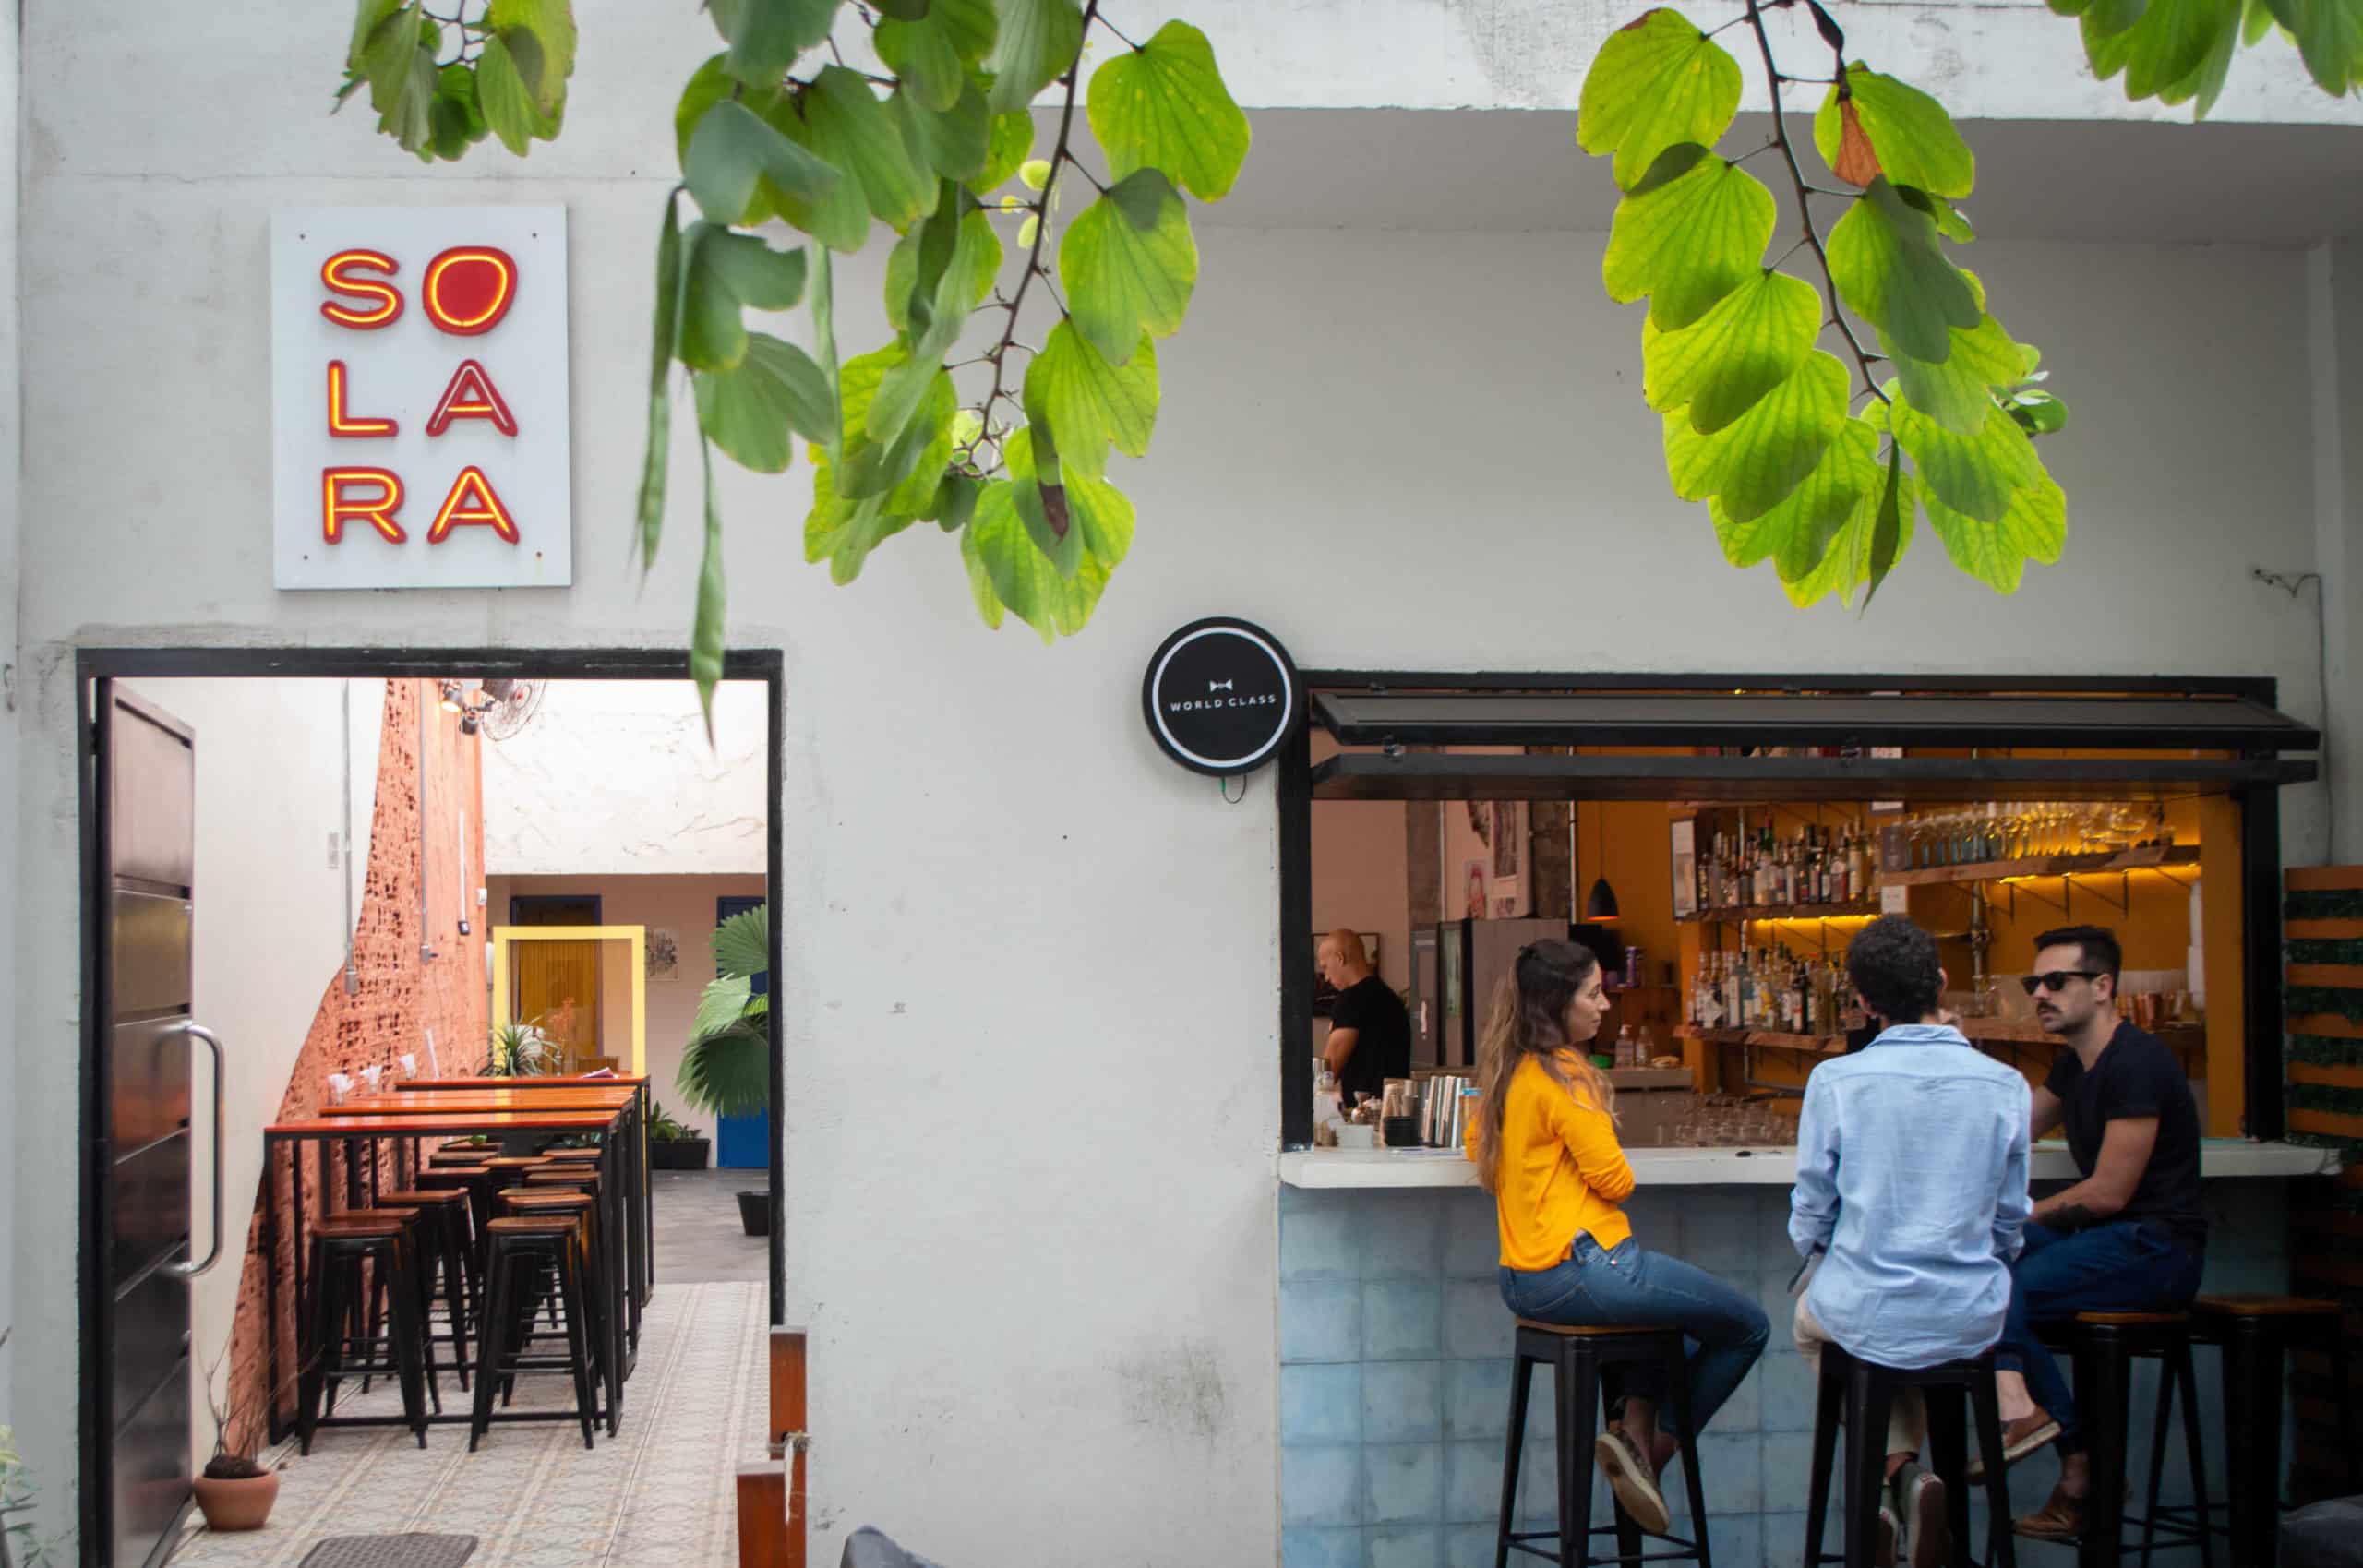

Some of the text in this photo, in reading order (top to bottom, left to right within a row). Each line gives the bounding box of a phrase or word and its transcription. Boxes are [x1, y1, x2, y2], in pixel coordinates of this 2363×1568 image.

[320, 246, 518, 336] SO
[328, 359, 518, 437] LA
[322, 465, 519, 545] RA
[1170, 694, 1277, 712] WORLD CLASS
